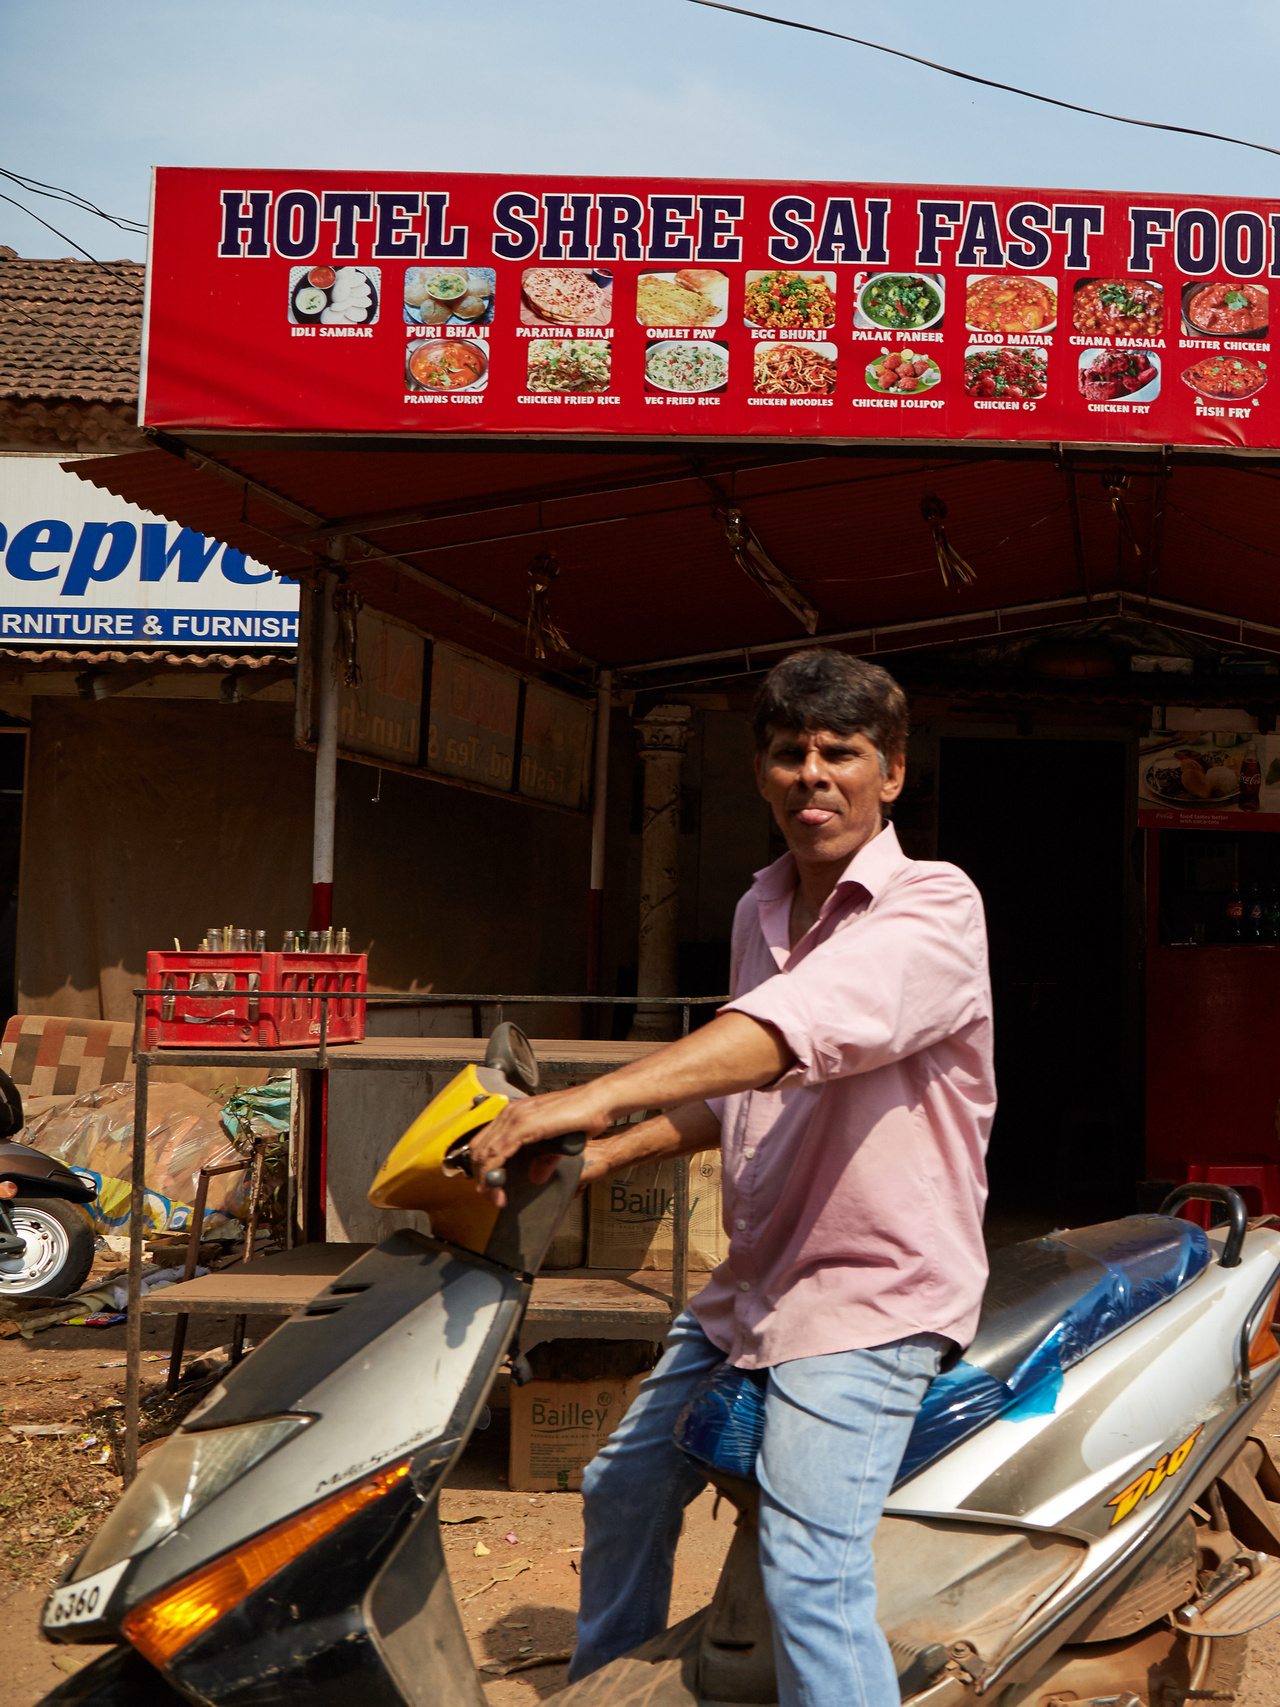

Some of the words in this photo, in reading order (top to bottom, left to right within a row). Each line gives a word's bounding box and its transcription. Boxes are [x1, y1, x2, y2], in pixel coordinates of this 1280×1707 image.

[217, 189, 468, 260] HOTEL
[492, 191, 745, 263] SHREE
[768, 195, 891, 266] SAI
[915, 199, 1104, 271] FAST
[291, 327, 316, 338] IDLI
[319, 327, 373, 338] SAMBAR
[406, 326, 442, 338] PURI
[446, 326, 490, 340] BHAJI
[516, 327, 573, 338] PARATHA
[577, 328, 614, 340] BHAJI
[646, 328, 690, 339] OMLET
[693, 329, 716, 339] PAV
[751, 329, 776, 340] EGG
[779, 330, 827, 342] BHURJI
[852, 331, 893, 342] PALAK
[896, 332, 944, 343] PANEER
[968, 333, 1004, 345] ALOO
[1007, 334, 1053, 347] MATAR
[1069, 336, 1112, 347] CHANA
[1115, 337, 1166, 349] MASALA
[1179, 339, 1221, 350] BUTTER
[1223, 341, 1271, 352] CHICKEN
[404, 395, 448, 404] PRAWNS
[450, 395, 485, 405] CURRY
[517, 395, 562, 404] CHICKEN
[564, 396, 595, 405] FRIED
[597, 396, 621, 405] RICE
[645, 396, 664, 405] VEG
[666, 396, 695, 406] FRIED
[698, 397, 721, 406] RICE
[747, 397, 787, 406] CHICKEN
[789, 398, 833, 407] NOODLES
[852, 398, 898, 408] CHICKEN
[901, 399, 945, 409] LOLIPOP
[974, 401, 1019, 410] CHICKEN
[1022, 401, 1037, 412] 65
[1087, 403, 1130, 413] CHICKEN
[1132, 404, 1150, 415] FRY
[1196, 406, 1225, 417] FISH
[1228, 407, 1251, 418] FRY
[142, 615, 164, 635] &
[173, 615, 299, 638] FURNISH
[532, 1403, 608, 1431] Bailley
